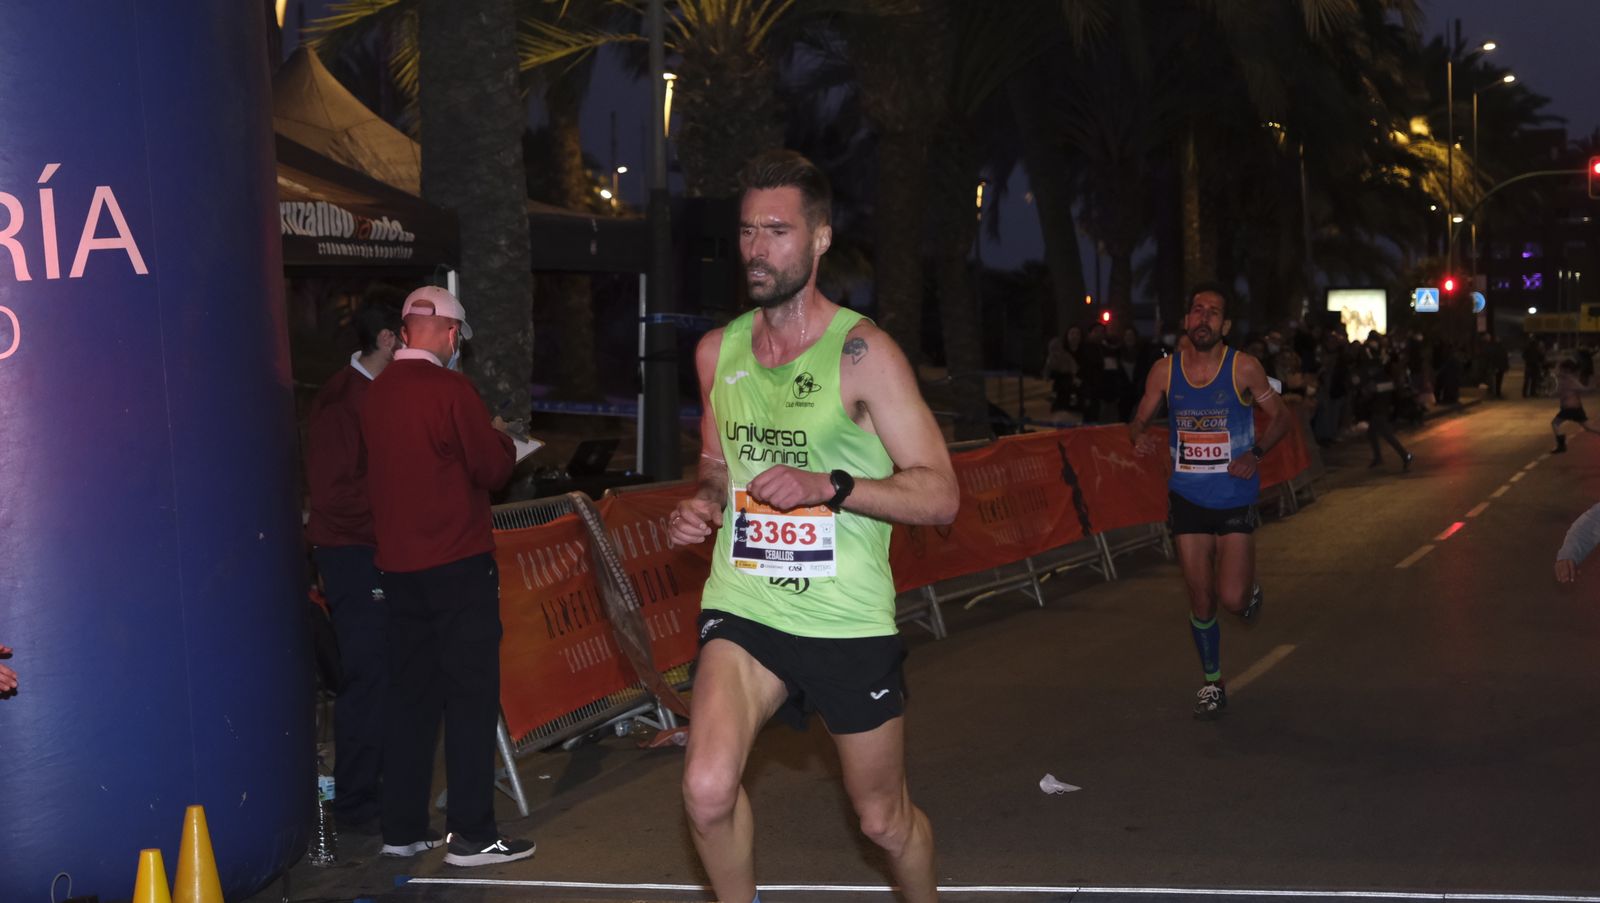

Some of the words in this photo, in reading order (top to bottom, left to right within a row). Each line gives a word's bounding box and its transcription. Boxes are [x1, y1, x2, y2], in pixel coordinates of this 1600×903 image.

[726, 420, 807, 447] Universo
[738, 444, 808, 467] Running
[1186, 446, 1222, 458] 3610
[748, 519, 817, 545] 3363
[764, 549, 795, 561] CEBALLOS
